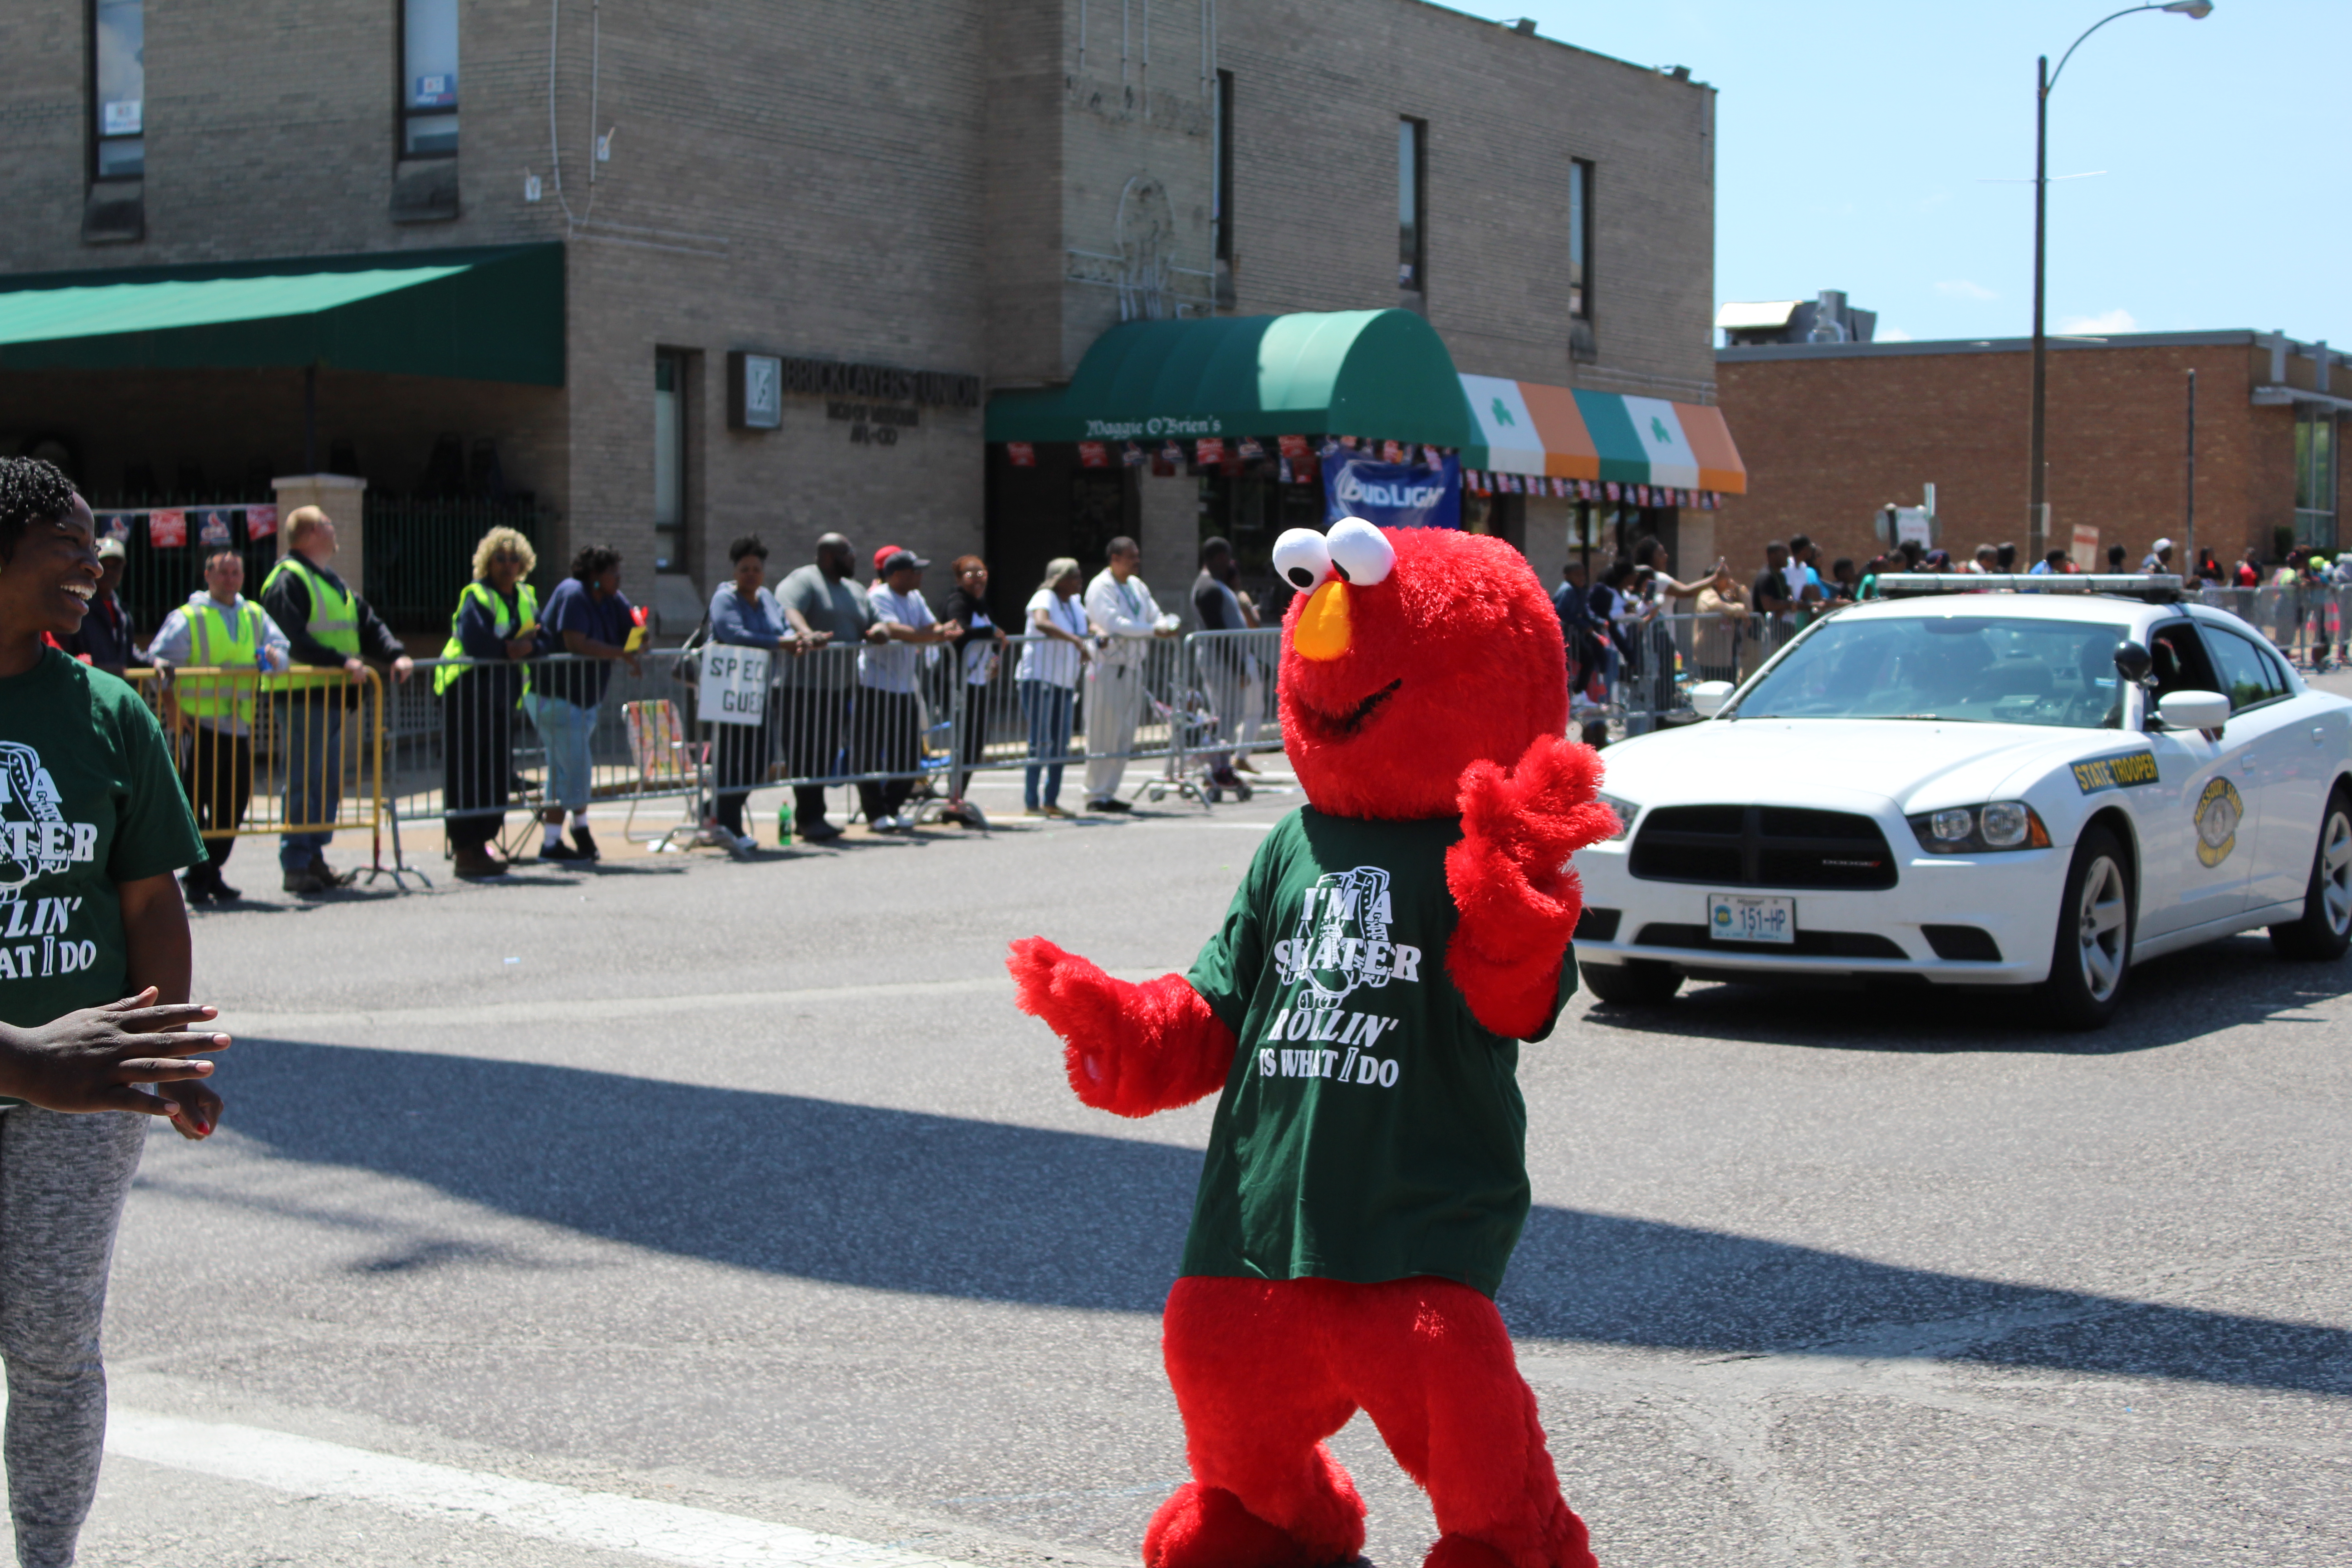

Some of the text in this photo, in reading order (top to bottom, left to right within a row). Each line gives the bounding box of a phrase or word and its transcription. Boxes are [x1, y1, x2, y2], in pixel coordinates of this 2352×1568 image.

[920, 371, 980, 407] UNION
[1086, 415, 1221, 440] Maggie O'Brien's
[28, 767, 63, 803] A
[2074, 753, 2158, 790] STATE TROOPER
[2195, 779, 2244, 825] MISSOURI STATE
[0, 821, 98, 862] TER
[0, 897, 83, 938] LIN'
[1300, 887, 1393, 924] I'M A
[1740, 907, 1786, 932] 151-HP
[41, 935, 55, 977] I
[59, 940, 97, 974] DO
[1274, 936, 1421, 982] SKATER
[1268, 1009, 1399, 1047] ROLLIN'
[1259, 1047, 1399, 1088] IS WHAT I DO
